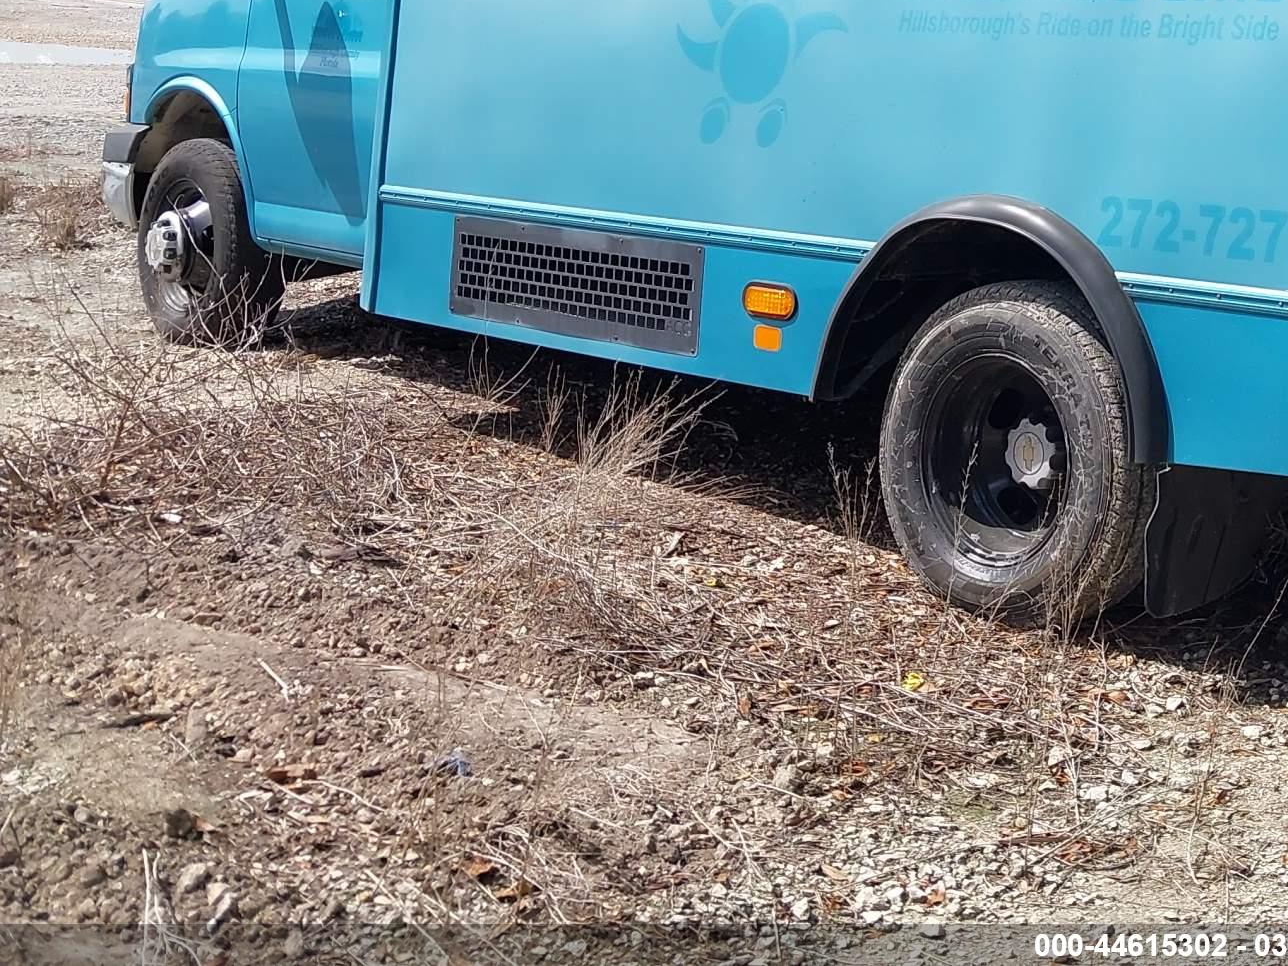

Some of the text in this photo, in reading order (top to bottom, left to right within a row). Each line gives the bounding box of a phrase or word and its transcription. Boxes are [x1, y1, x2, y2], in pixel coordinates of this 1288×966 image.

[897, 9, 1031, 41] Hillsborough's
[1036, 11, 1080, 38] Ride
[1119, 13, 1153, 39] the
[1158, 13, 1225, 46] Bright
[1231, 13, 1281, 42] Side
